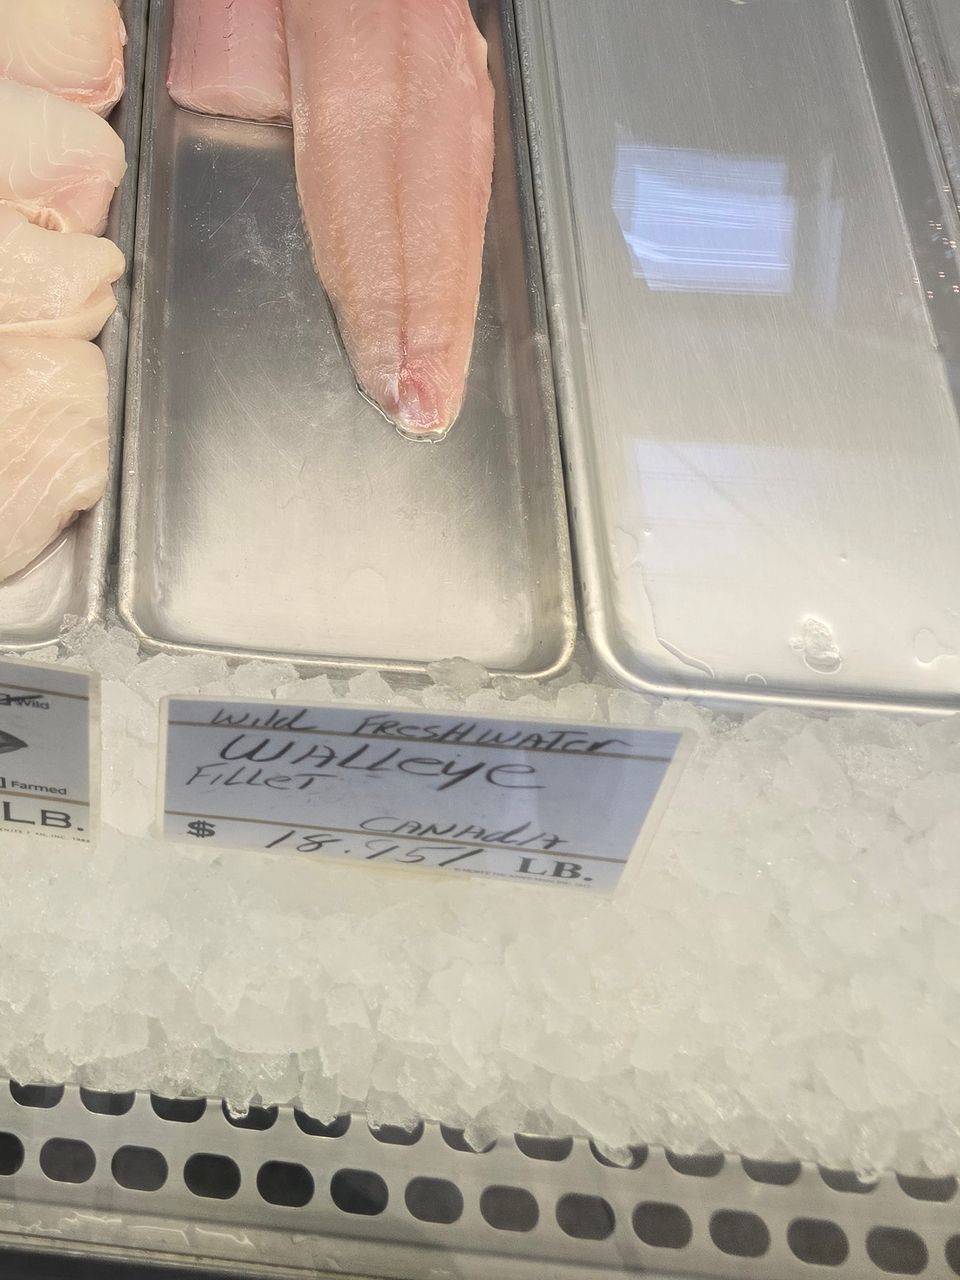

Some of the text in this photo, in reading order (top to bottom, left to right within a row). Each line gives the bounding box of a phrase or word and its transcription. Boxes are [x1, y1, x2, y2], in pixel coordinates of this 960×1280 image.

[211, 708, 318, 730] Wild
[11, 780, 67, 795] Farmed
[3, 801, 85, 834] LB.
[187, 820, 216, 838] $
[515, 856, 593, 882] LB.
